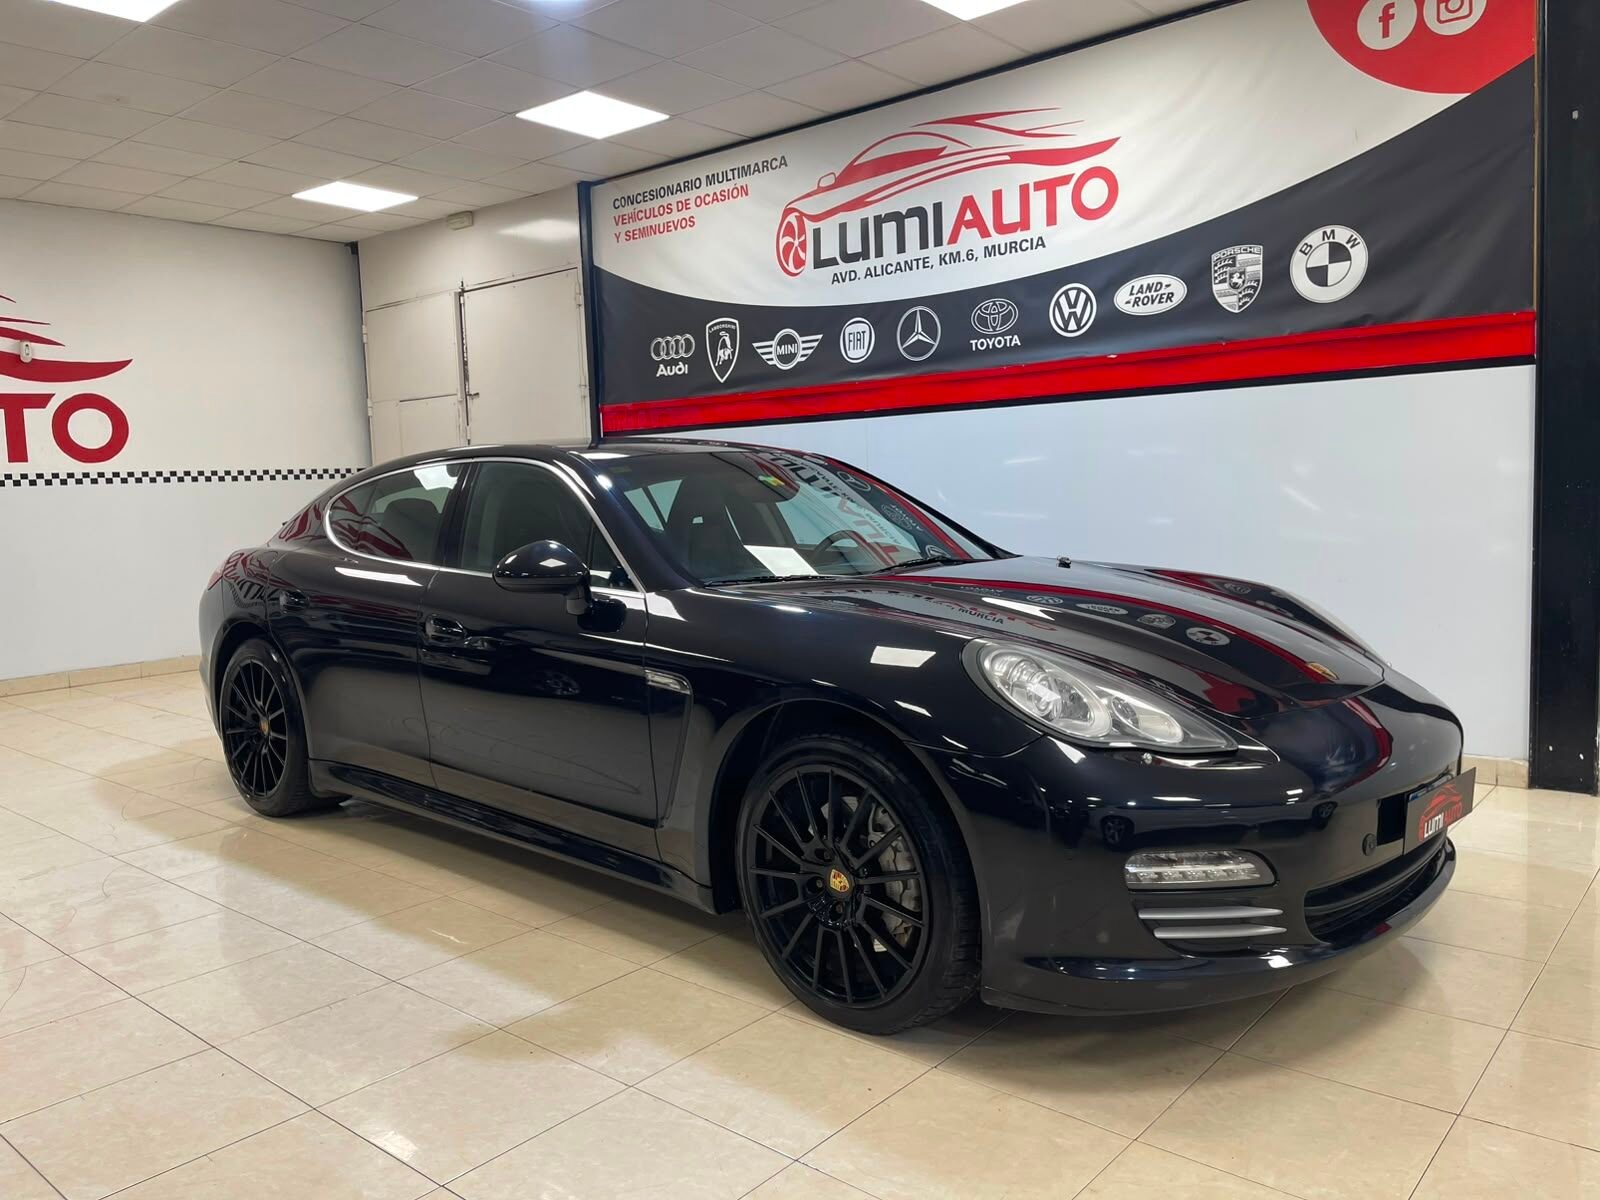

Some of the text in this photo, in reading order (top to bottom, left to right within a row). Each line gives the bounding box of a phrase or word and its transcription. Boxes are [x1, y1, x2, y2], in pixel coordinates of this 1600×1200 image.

[612, 155, 788, 210] CONCESIONARIO MULTIMARCA
[613, 183, 749, 227] VEHÍCULOS DE OCASIÓN
[614, 215, 696, 244] Y SEMINUEVOS
[831, 236, 1047, 285] AVD. ALICANTE, KM.6, MURCIA
[1213, 246, 1262, 261] PORSCHE
[776, 343, 798, 356] MINI
[848, 329, 867, 352] FIAT
[969, 334, 1022, 352] TOYOTA
